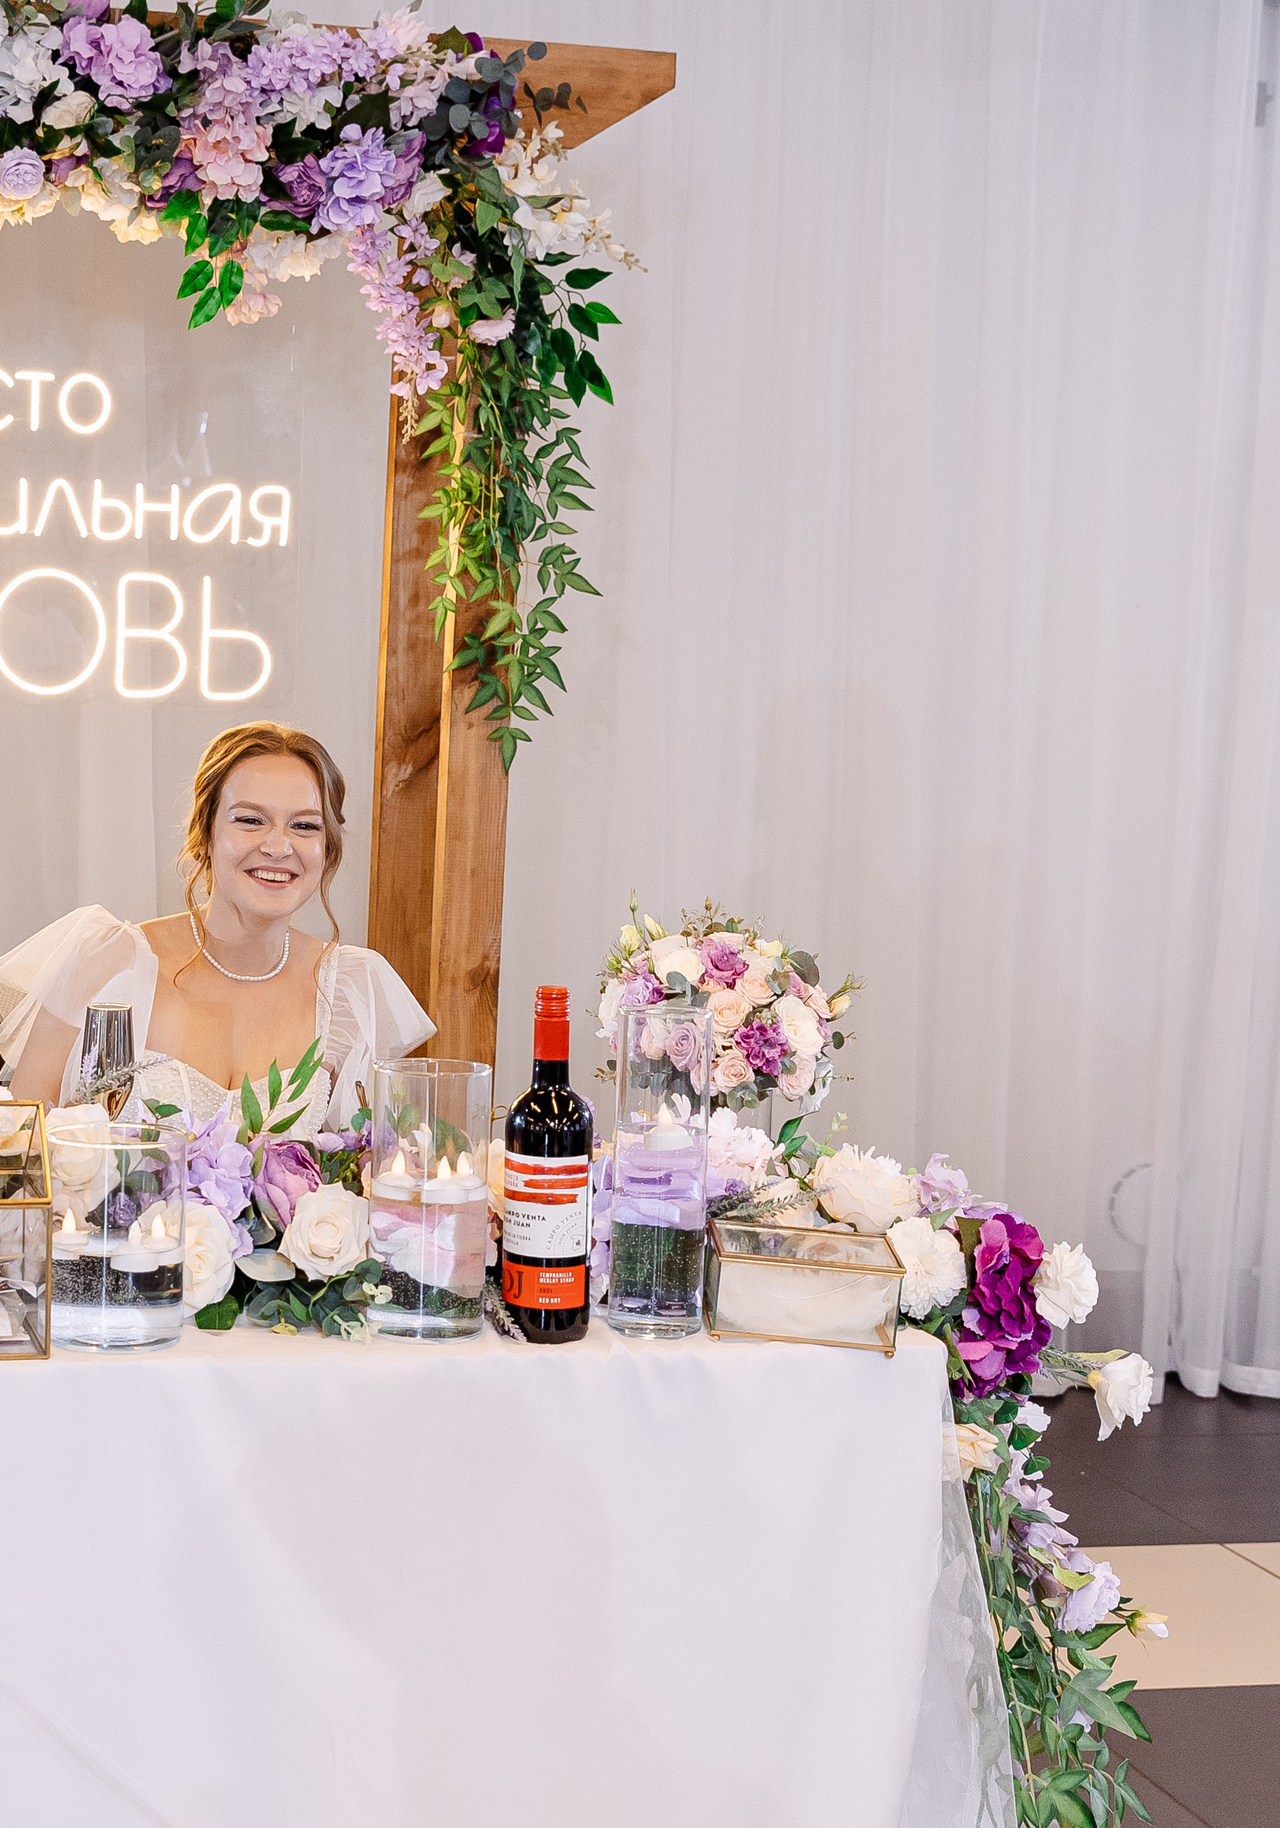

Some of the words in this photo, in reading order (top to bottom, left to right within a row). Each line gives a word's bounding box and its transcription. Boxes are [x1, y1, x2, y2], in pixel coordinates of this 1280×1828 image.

[521, 1213, 547, 1222] VENTA
[513, 1219, 531, 1228] JUAN
[546, 1224, 561, 1250] CAMPO
[560, 1210, 582, 1225] VENTA
[538, 1296, 550, 1304] RED
